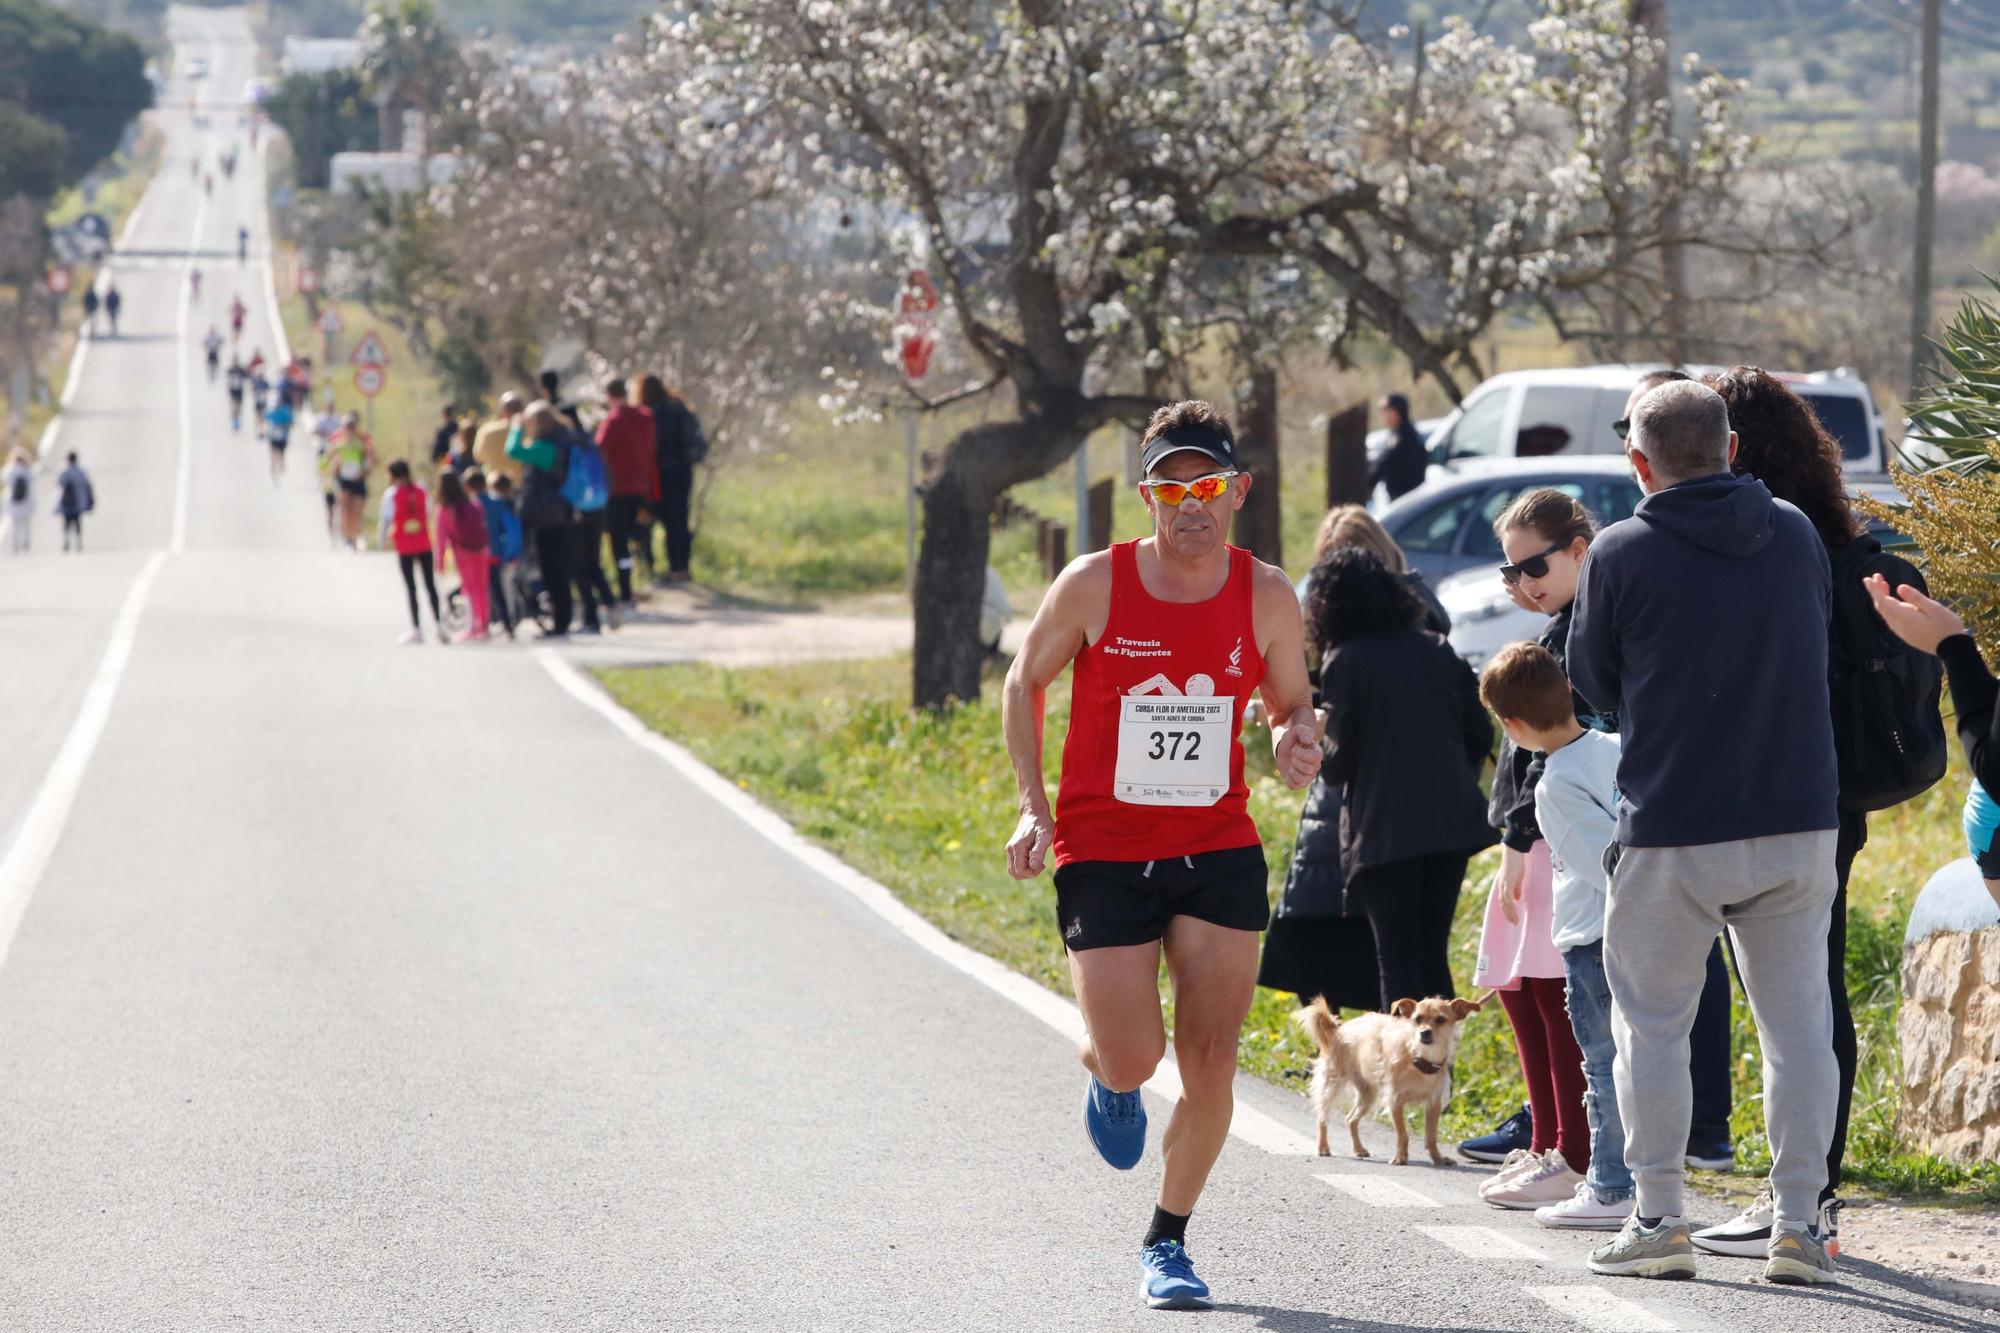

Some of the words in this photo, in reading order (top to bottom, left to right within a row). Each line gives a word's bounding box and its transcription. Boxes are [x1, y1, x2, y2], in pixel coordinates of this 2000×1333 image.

[1116, 637, 1161, 647] Travessia
[1103, 646, 1119, 655] Ses
[1120, 648, 1172, 658] Figueretes
[1135, 704, 1154, 713] CURSA
[1155, 705, 1170, 713] FLOR
[1170, 705, 1205, 714] D'AMETLLER
[1206, 705, 1220, 714] 2023
[1148, 731, 1201, 761] 372
